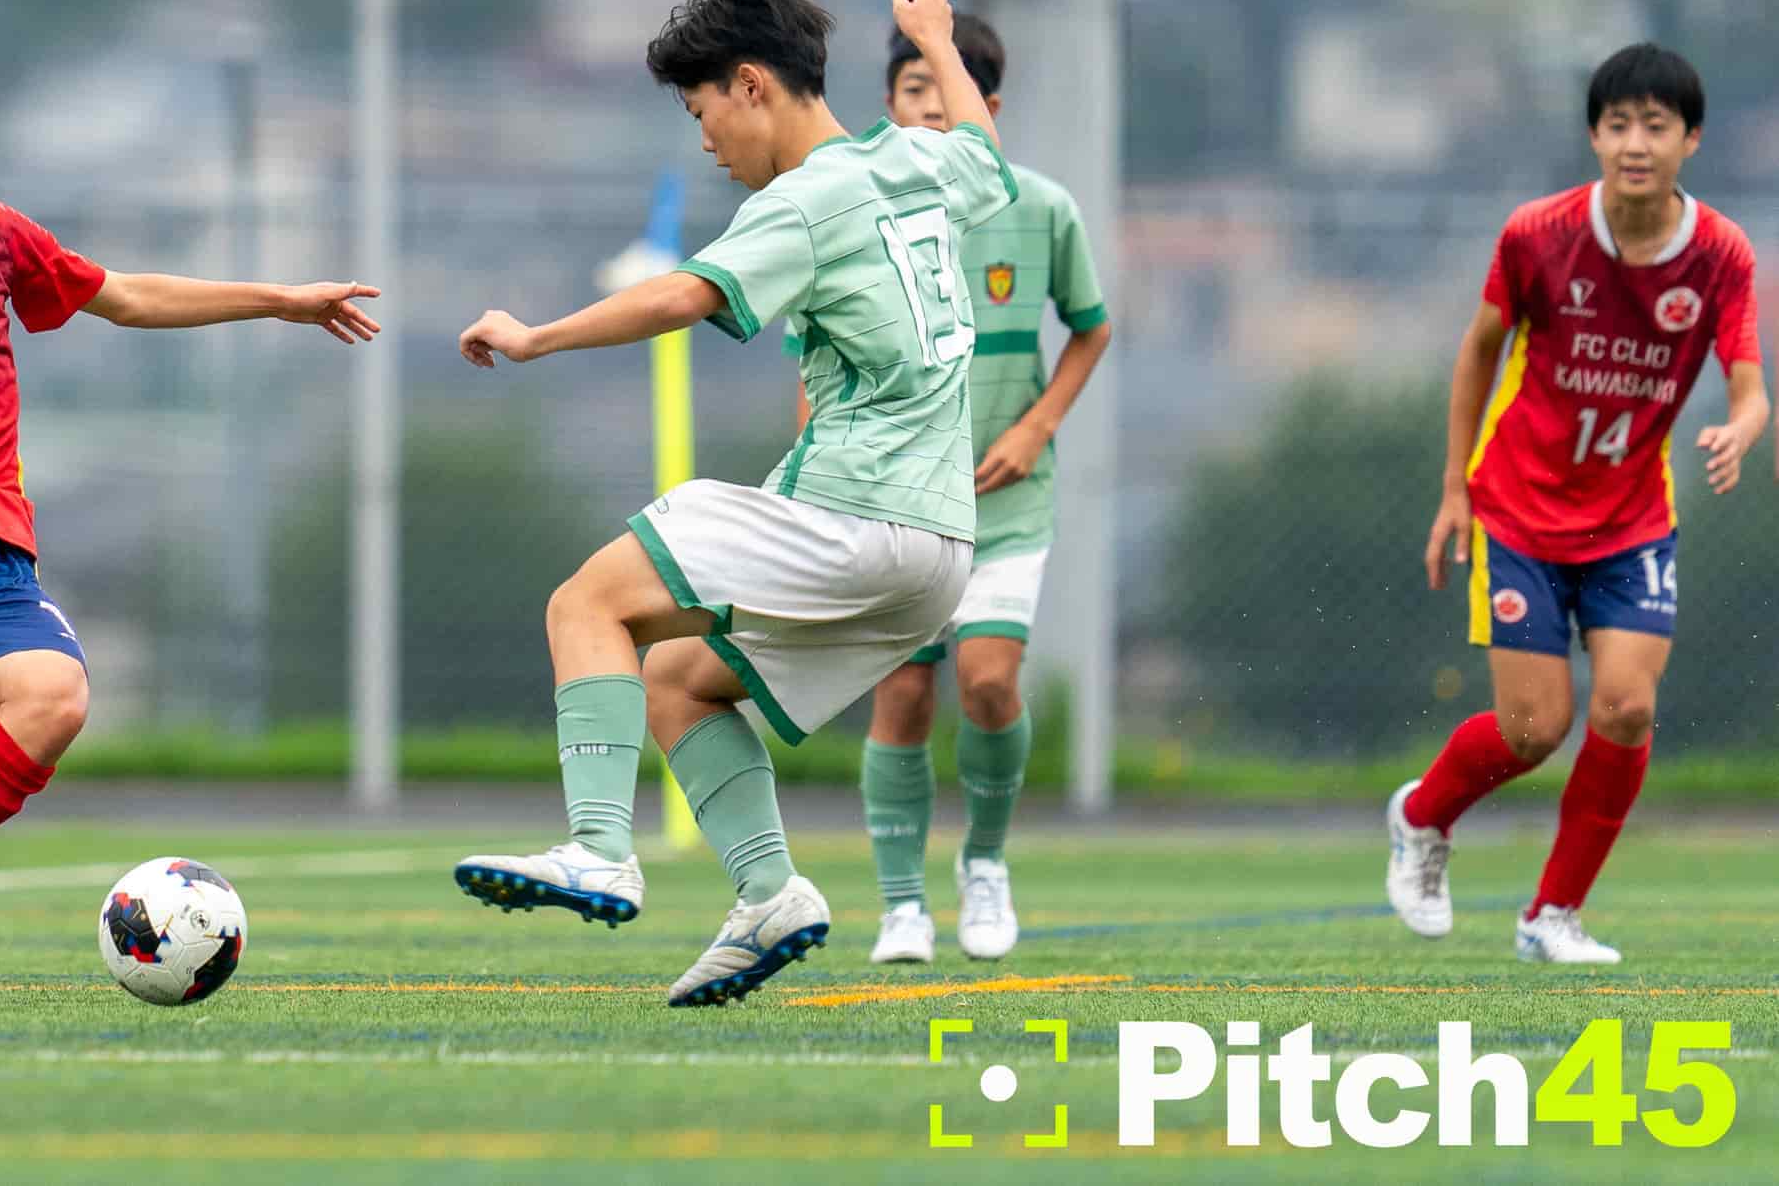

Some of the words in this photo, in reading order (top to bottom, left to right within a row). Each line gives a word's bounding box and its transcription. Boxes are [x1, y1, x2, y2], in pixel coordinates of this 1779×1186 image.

[876, 203, 975, 370] 13
[1570, 333, 1606, 361] FC
[1611, 337, 1671, 367] CLIO
[1572, 407, 1634, 467] 14
